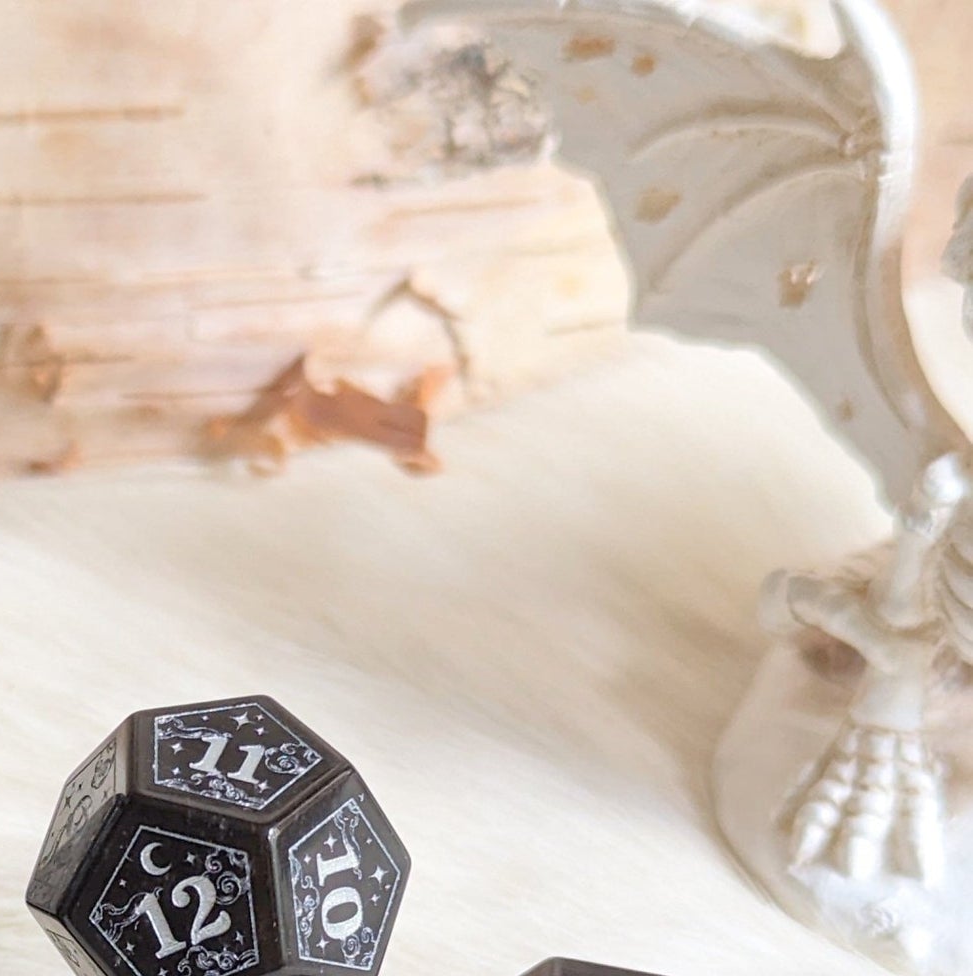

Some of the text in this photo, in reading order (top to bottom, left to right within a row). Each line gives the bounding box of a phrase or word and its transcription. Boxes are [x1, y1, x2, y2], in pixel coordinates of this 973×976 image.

[189, 735, 266, 785] 11
[140, 875, 232, 959] 12
[316, 852, 364, 940] 10
